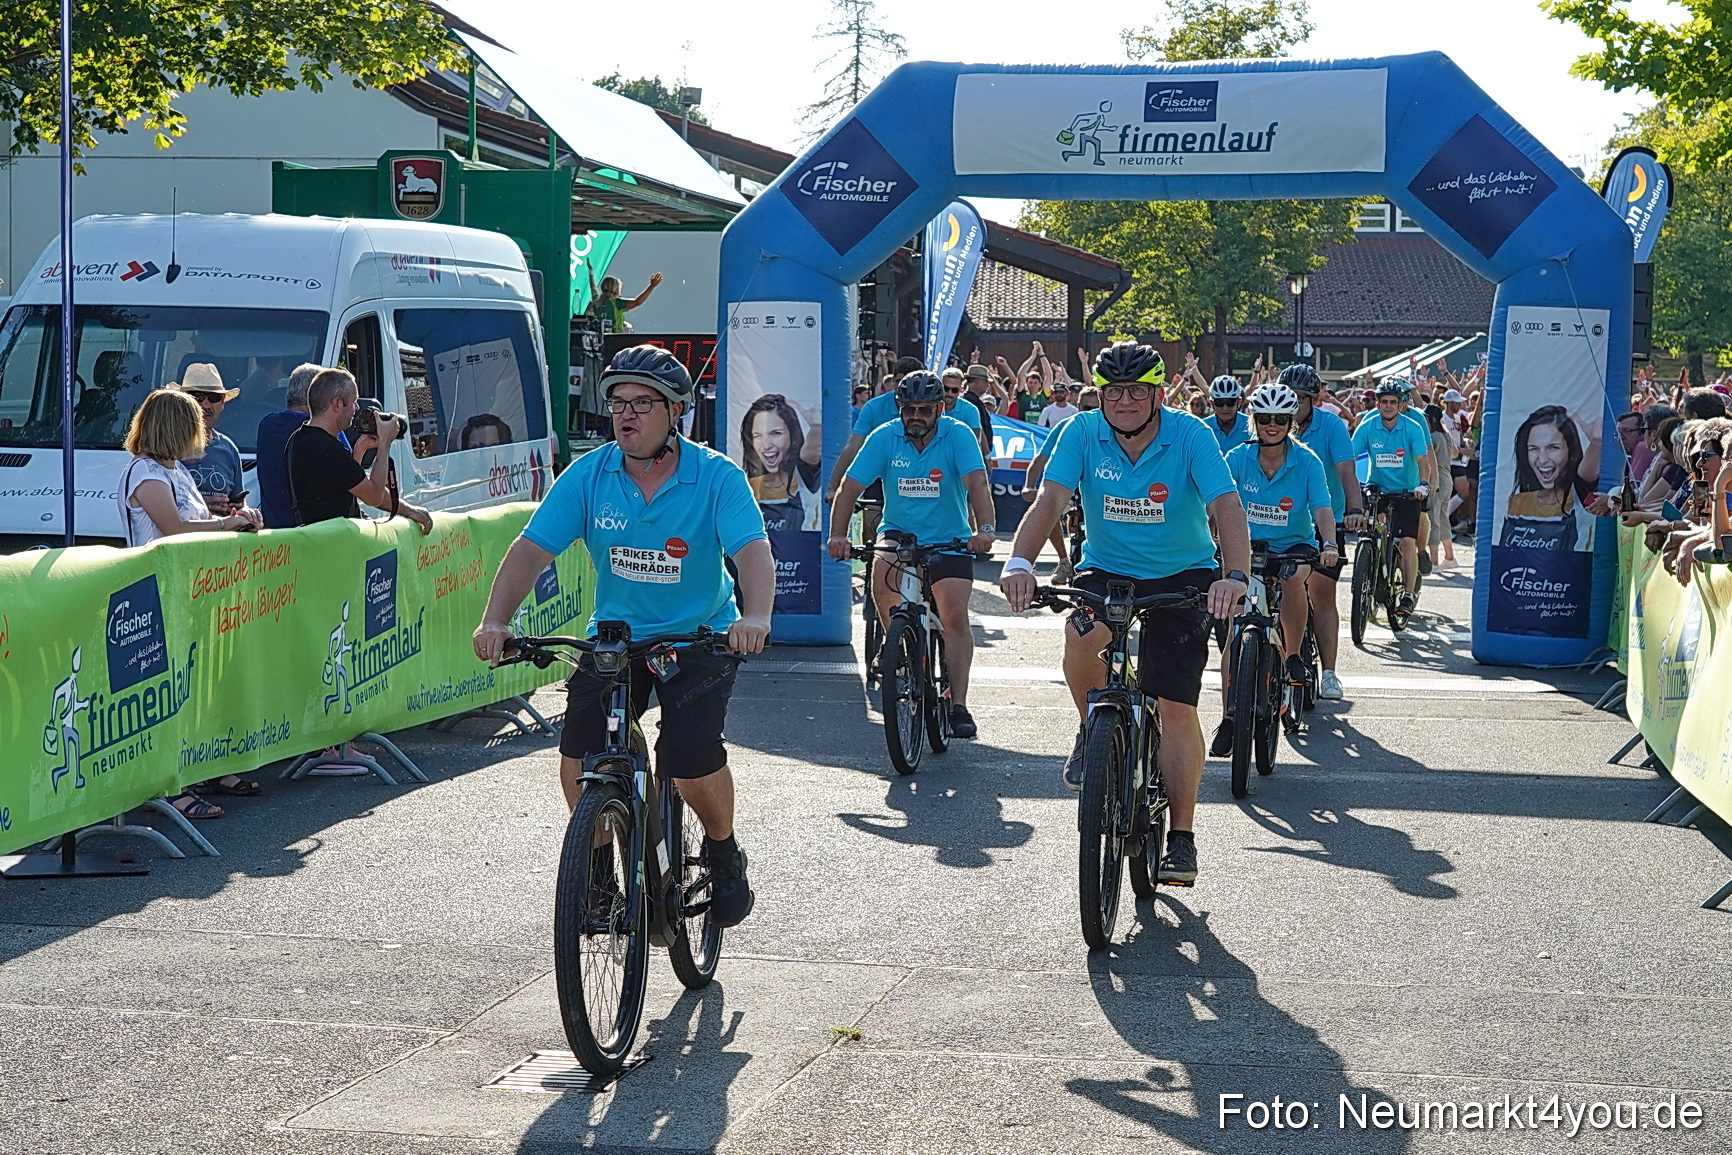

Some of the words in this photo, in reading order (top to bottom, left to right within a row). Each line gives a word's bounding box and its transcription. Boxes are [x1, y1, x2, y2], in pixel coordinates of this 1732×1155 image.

[1159, 97, 1212, 107] Fischer
[1118, 122, 1279, 153] firmenlauf
[1118, 154, 1184, 166] neumarkt
[812, 174, 898, 194] Fischer
[1437, 175, 1461, 190] und
[1463, 172, 1486, 185] das
[1488, 171, 1538, 184] Lächeln
[819, 193, 889, 203] AUTOMOBILE
[1468, 187, 1502, 204] fährt
[1505, 184, 1534, 196] mit!
[405, 205, 430, 217] 1628
[1638, 212, 1651, 232] und
[1645, 179, 1665, 213] Medien
[40, 262, 119, 279] abvent
[945, 271, 958, 307] Druck
[956, 260, 966, 280] und
[963, 225, 978, 260] Medien
[185, 271, 303, 285] DATASPORT
[891, 460, 911, 468] NOW
[488, 454, 529, 498] abavent
[1094, 467, 1123, 481] NOW
[1242, 484, 1260, 494] NOW
[597, 502, 625, 518] Bike
[1105, 496, 1141, 507] E-BIKES
[1143, 499, 1151, 507] &
[1248, 502, 1273, 512] E-BIKES
[1104, 505, 1163, 516] FAHRRÄDER
[1247, 510, 1288, 521] FAHRRÄDER
[594, 518, 629, 531] NOW
[611, 547, 655, 561] E-BIKES
[657, 552, 667, 562] &
[192, 546, 250, 600] Gesunde
[252, 543, 291, 578] Firmen
[611, 557, 680, 574] FAHRRÄDER
[612, 567, 625, 577] DEIN
[625, 572, 645, 581] NEUER
[370, 577, 393, 598] Fischer
[1511, 577, 1571, 592] Fischer
[217, 590, 255, 635] laufen
[257, 569, 298, 623] länger!
[1515, 591, 1566, 599] AUTOMOBILE
[527, 575, 583, 639] firmenlauf
[115, 611, 153, 639] Fischer
[119, 628, 152, 648] AUTOMOBILE
[351, 605, 426, 688] firmenlauf
[87, 641, 197, 754] firmenlauf
[355, 675, 389, 707] neumarkt
[92, 732, 153, 778] neumarkt
